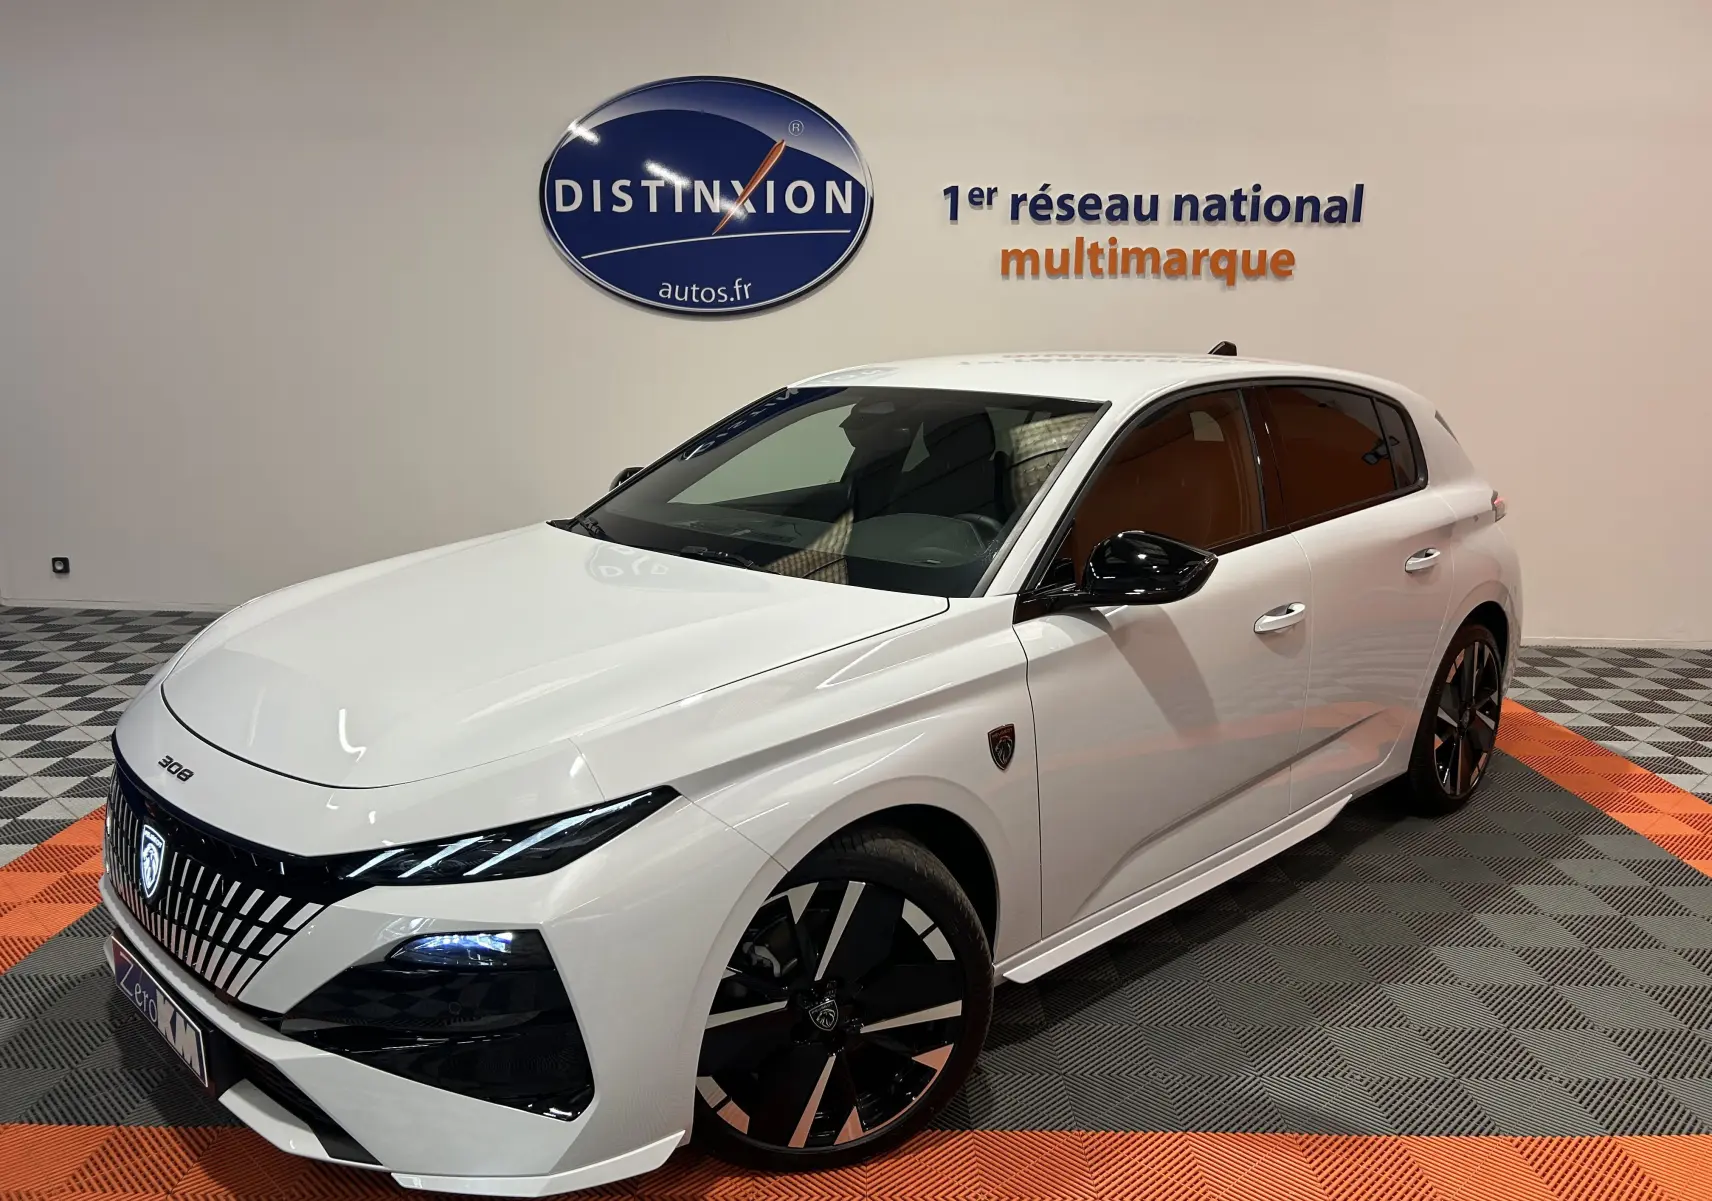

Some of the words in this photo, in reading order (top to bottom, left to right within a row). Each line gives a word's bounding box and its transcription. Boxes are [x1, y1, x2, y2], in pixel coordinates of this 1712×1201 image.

[554, 179, 852, 214] DISTINXION
[943, 184, 998, 222] 1er
[1010, 184, 1159, 222] réseau
[1173, 184, 1365, 223] national
[1001, 237, 1295, 287] multimarque
[658, 278, 751, 303] autos.fr
[158, 755, 194, 782] 308
